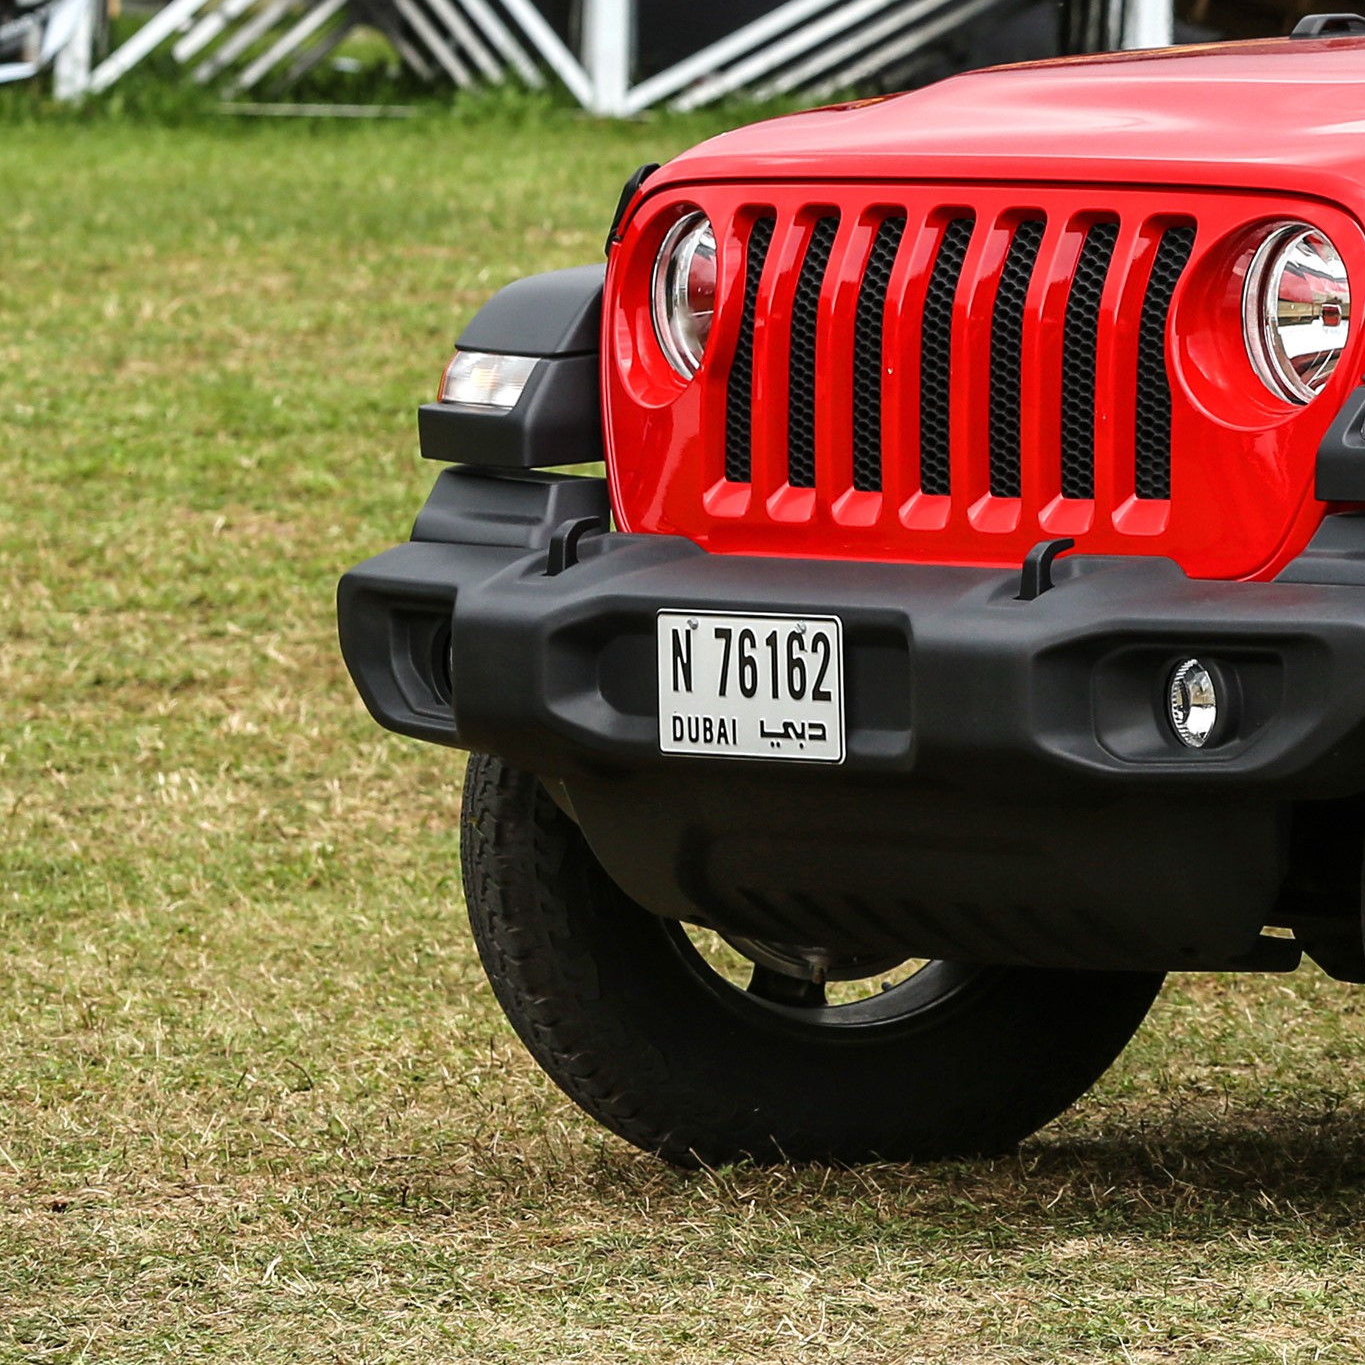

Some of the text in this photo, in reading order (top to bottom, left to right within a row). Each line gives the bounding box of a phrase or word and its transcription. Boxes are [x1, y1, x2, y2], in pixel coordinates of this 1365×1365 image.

[671, 627, 832, 702] N 76162
[672, 714, 737, 745] DUBAI
